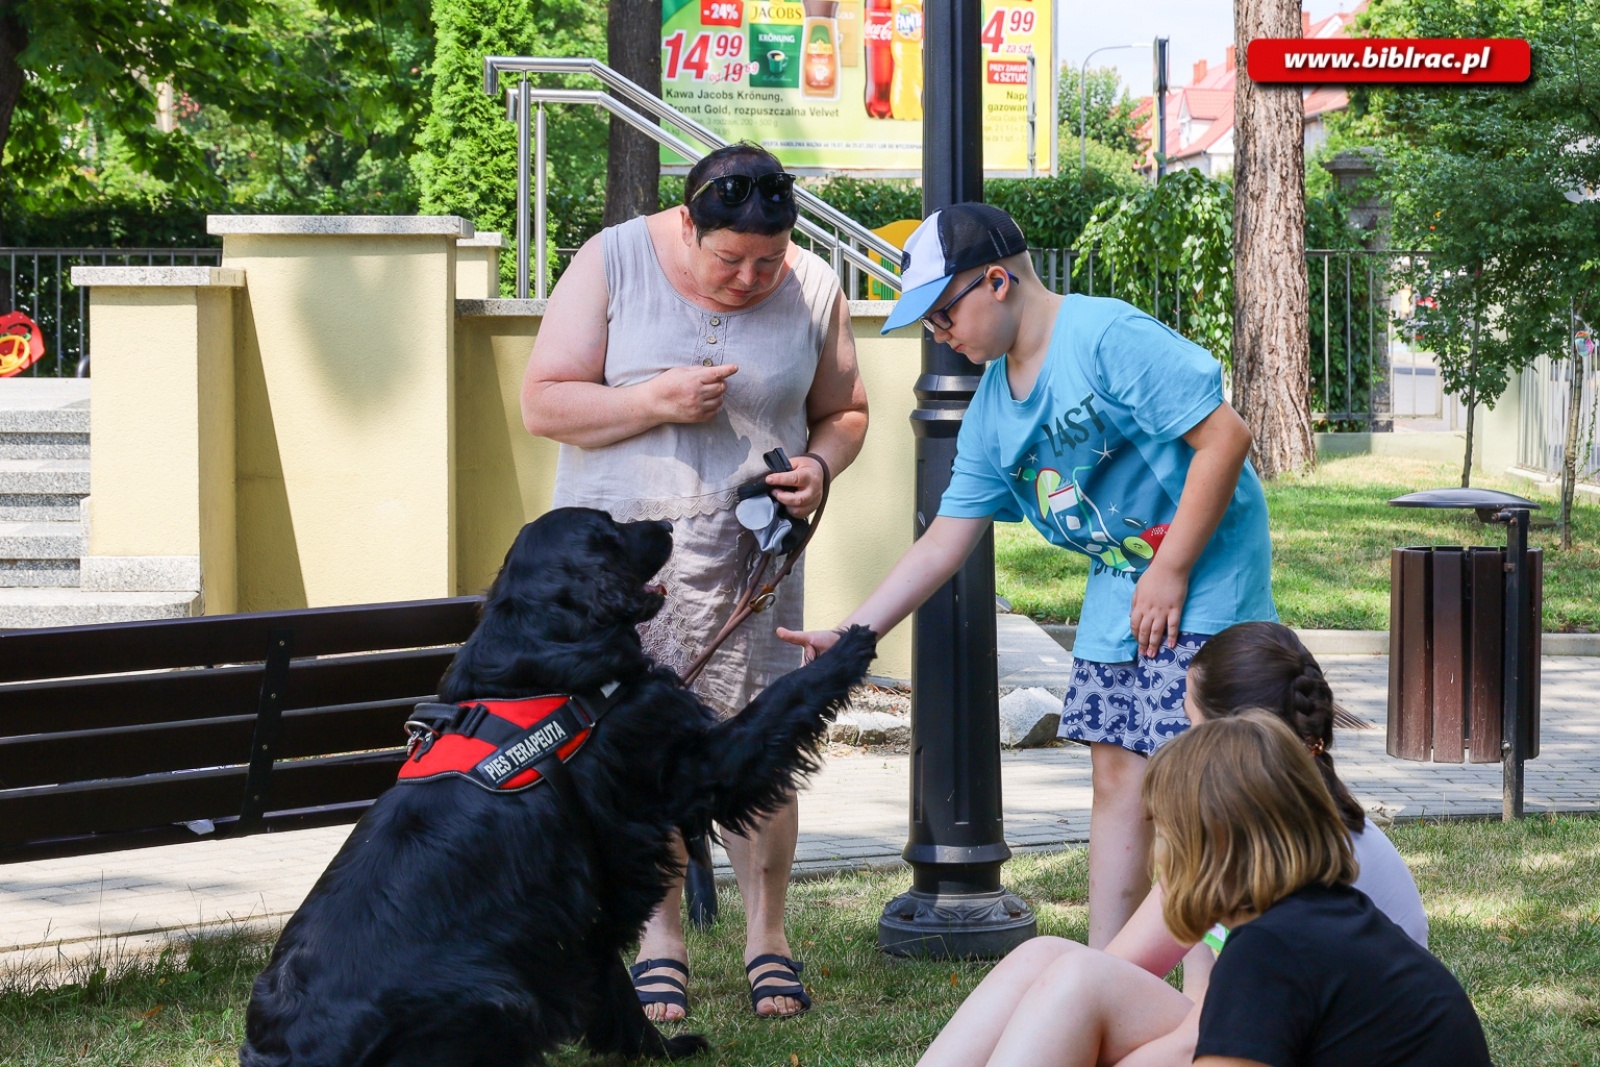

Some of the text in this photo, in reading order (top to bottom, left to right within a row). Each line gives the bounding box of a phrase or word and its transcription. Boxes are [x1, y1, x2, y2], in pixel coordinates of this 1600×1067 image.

[751, 6, 802, 19] JACOBS
[982, 10, 1034, 53] 4 99
[665, 32, 743, 79] 14 99
[666, 88, 783, 102] Kawa Jacobs Krönung,
[704, 104, 731, 115] Gold,
[734, 106, 806, 117] rozpuszczalna
[809, 107, 839, 117] Velvet
[1041, 393, 1106, 458] LAST
[483, 755, 512, 780] PIES
[505, 720, 566, 766] TERAPEUTA
